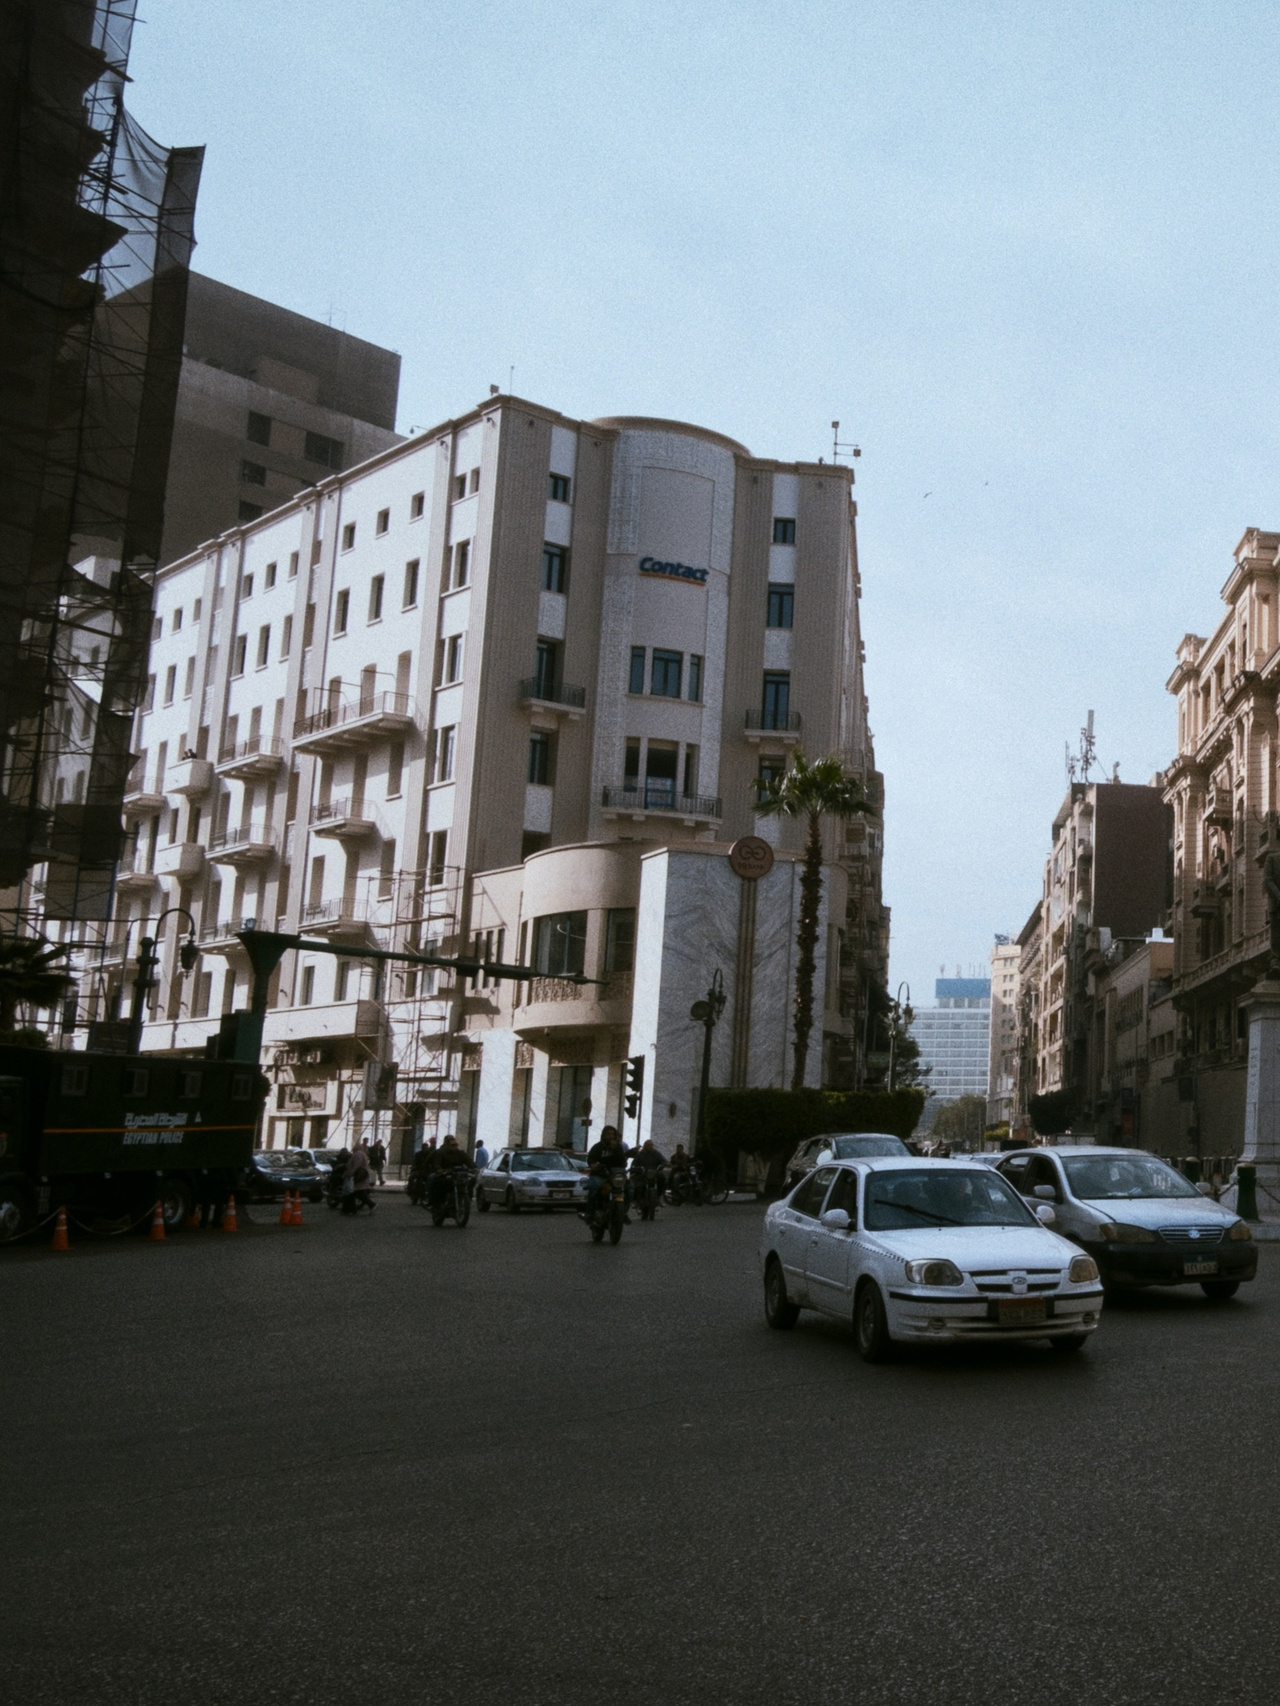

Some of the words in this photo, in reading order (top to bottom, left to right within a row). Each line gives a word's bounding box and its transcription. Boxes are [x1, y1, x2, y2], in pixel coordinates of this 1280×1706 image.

[639, 556, 710, 582] Contact
[122, 1131, 159, 1145] EGYPTIAN
[159, 1131, 185, 1144] POLICE
